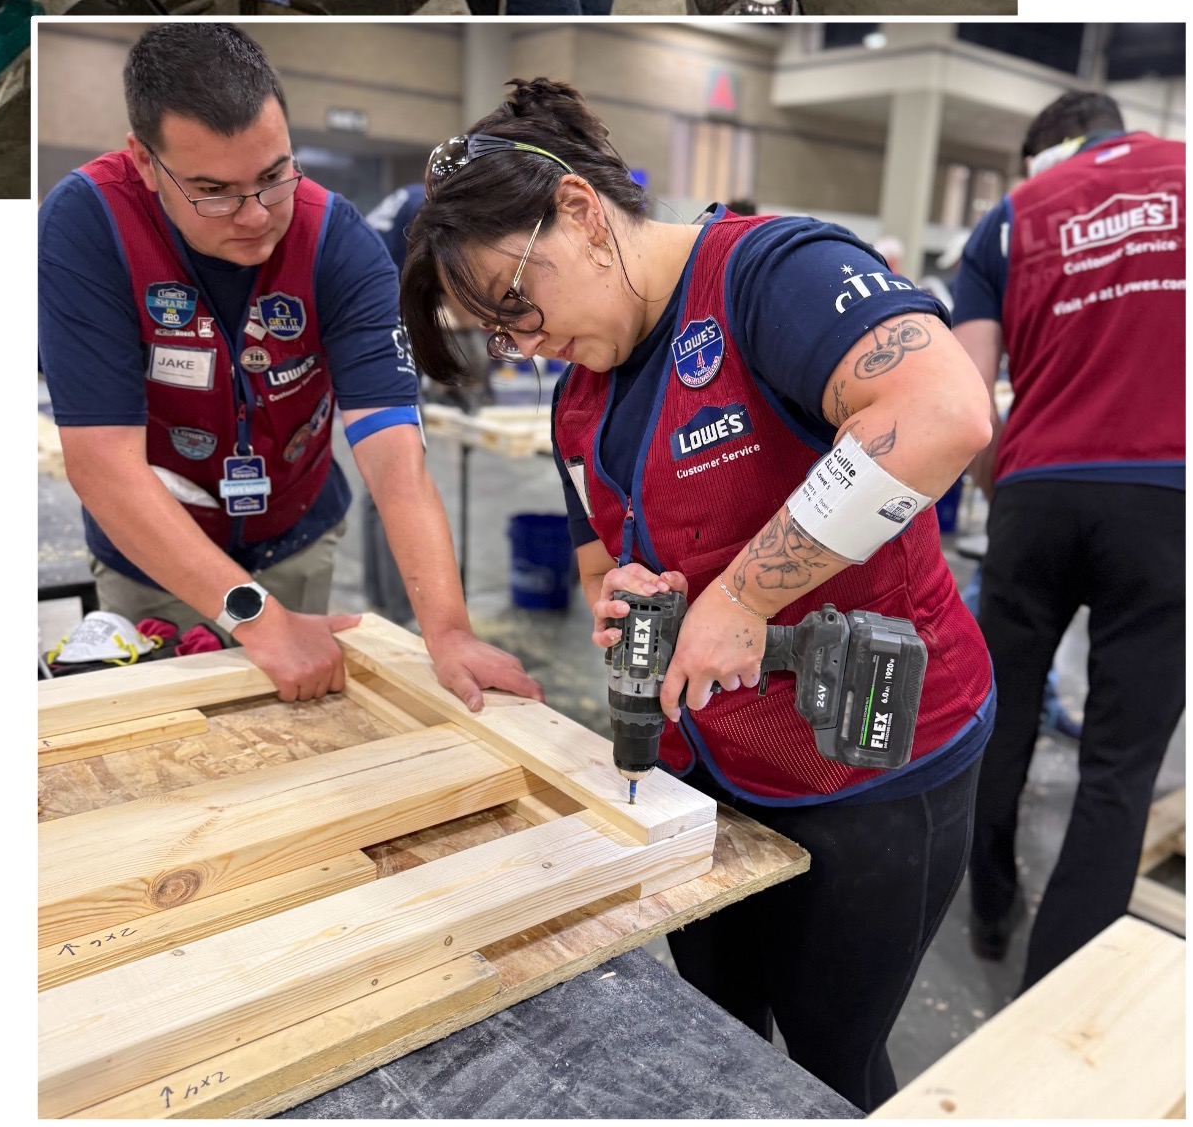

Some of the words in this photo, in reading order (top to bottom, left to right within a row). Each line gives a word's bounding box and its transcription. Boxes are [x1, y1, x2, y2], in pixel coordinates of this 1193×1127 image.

[1072, 203, 1165, 245] LOWE'S
[1063, 248, 1124, 275] Customer
[1125, 240, 1177, 256] Service
[155, 299, 187, 309] SMART
[163, 313, 180, 321] PRO
[269, 318, 287, 326] GET
[290, 318, 299, 326] IT
[678, 325, 717, 356] LOWE'S
[158, 358, 195, 370] JAKE
[696, 350, 706, 369] 4
[678, 413, 744, 454] LOWE'S
[676, 460, 720, 479] Customer
[722, 443, 760, 463] Service
[816, 469, 831, 490] Lowe's
[825, 458, 853, 490] ELLIOTT
[813, 503, 824, 517] Train
[818, 498, 829, 511] Train
[632, 617, 652, 666] FLEX
[816, 685, 827, 708] 24V
[871, 712, 888, 749] FLEX
